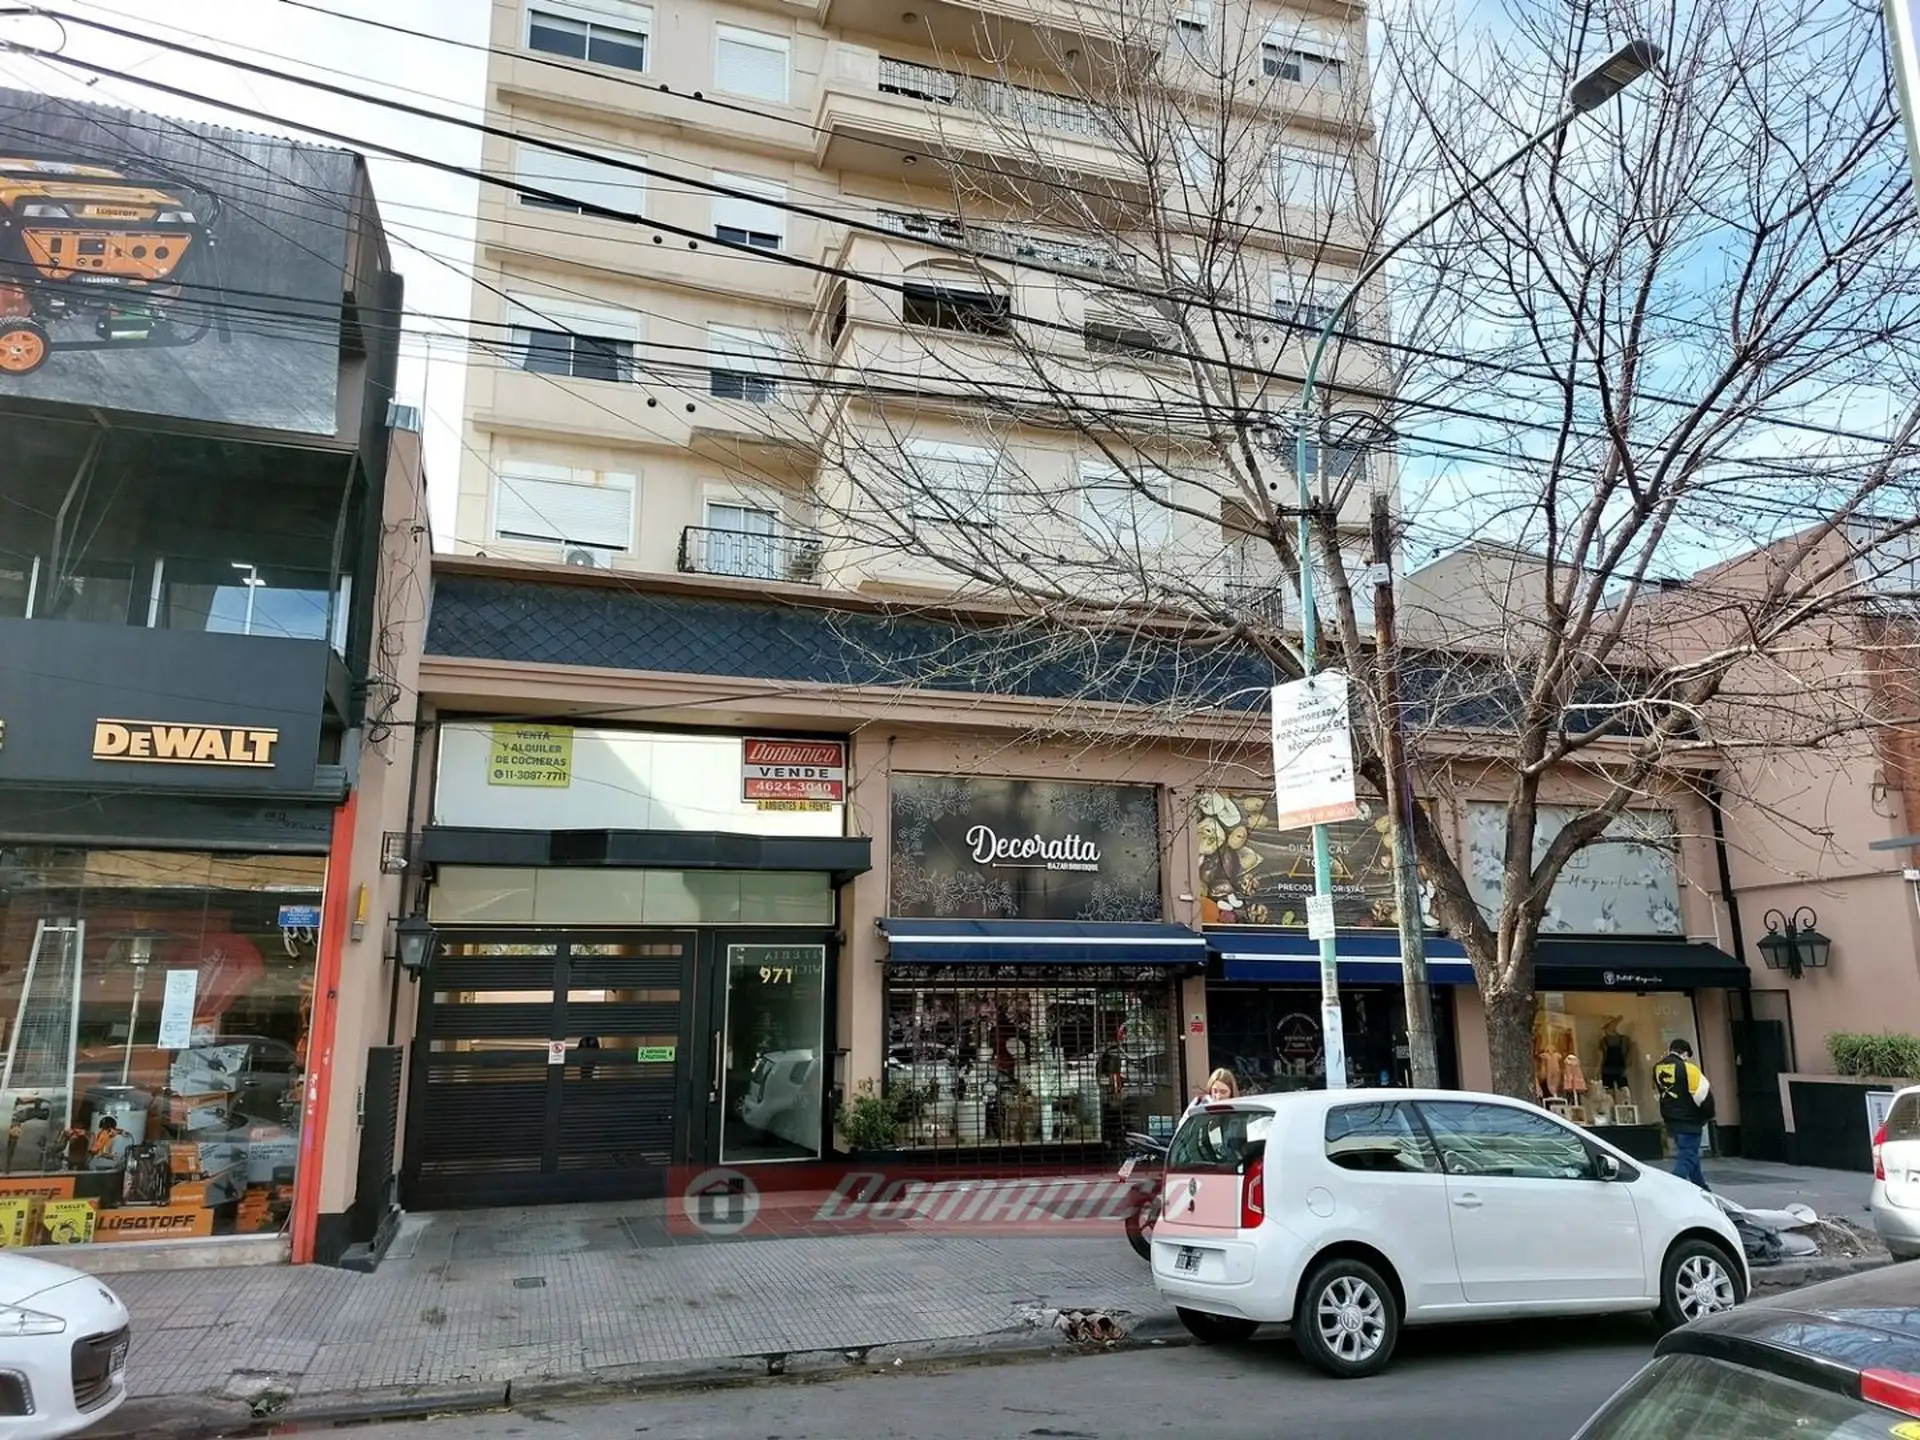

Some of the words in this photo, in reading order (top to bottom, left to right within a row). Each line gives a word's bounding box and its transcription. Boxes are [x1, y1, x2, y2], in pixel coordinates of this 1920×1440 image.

[1297, 698, 1320, 710] ZONA
[1281, 707, 1338, 726] MONITOREADA
[1333, 719, 1344, 728] DE
[517, 730, 551, 740] VENTA
[503, 743, 510, 751] Y
[511, 743, 562, 753] ALQUILER
[495, 755, 509, 764] DE
[511, 756, 567, 766] COCHERAS
[505, 769, 567, 781] 11-3087-7711
[760, 767, 829, 778] VENDE
[756, 781, 831, 792] 4624-3040
[765, 801, 797, 811] AMBIENTES
[800, 801, 807, 811] AL
[809, 802, 832, 811] FRENTE
[966, 825, 1101, 864] Decoratta
[1278, 883, 1313, 892] PRECIOS
[759, 966, 792, 984] 971
